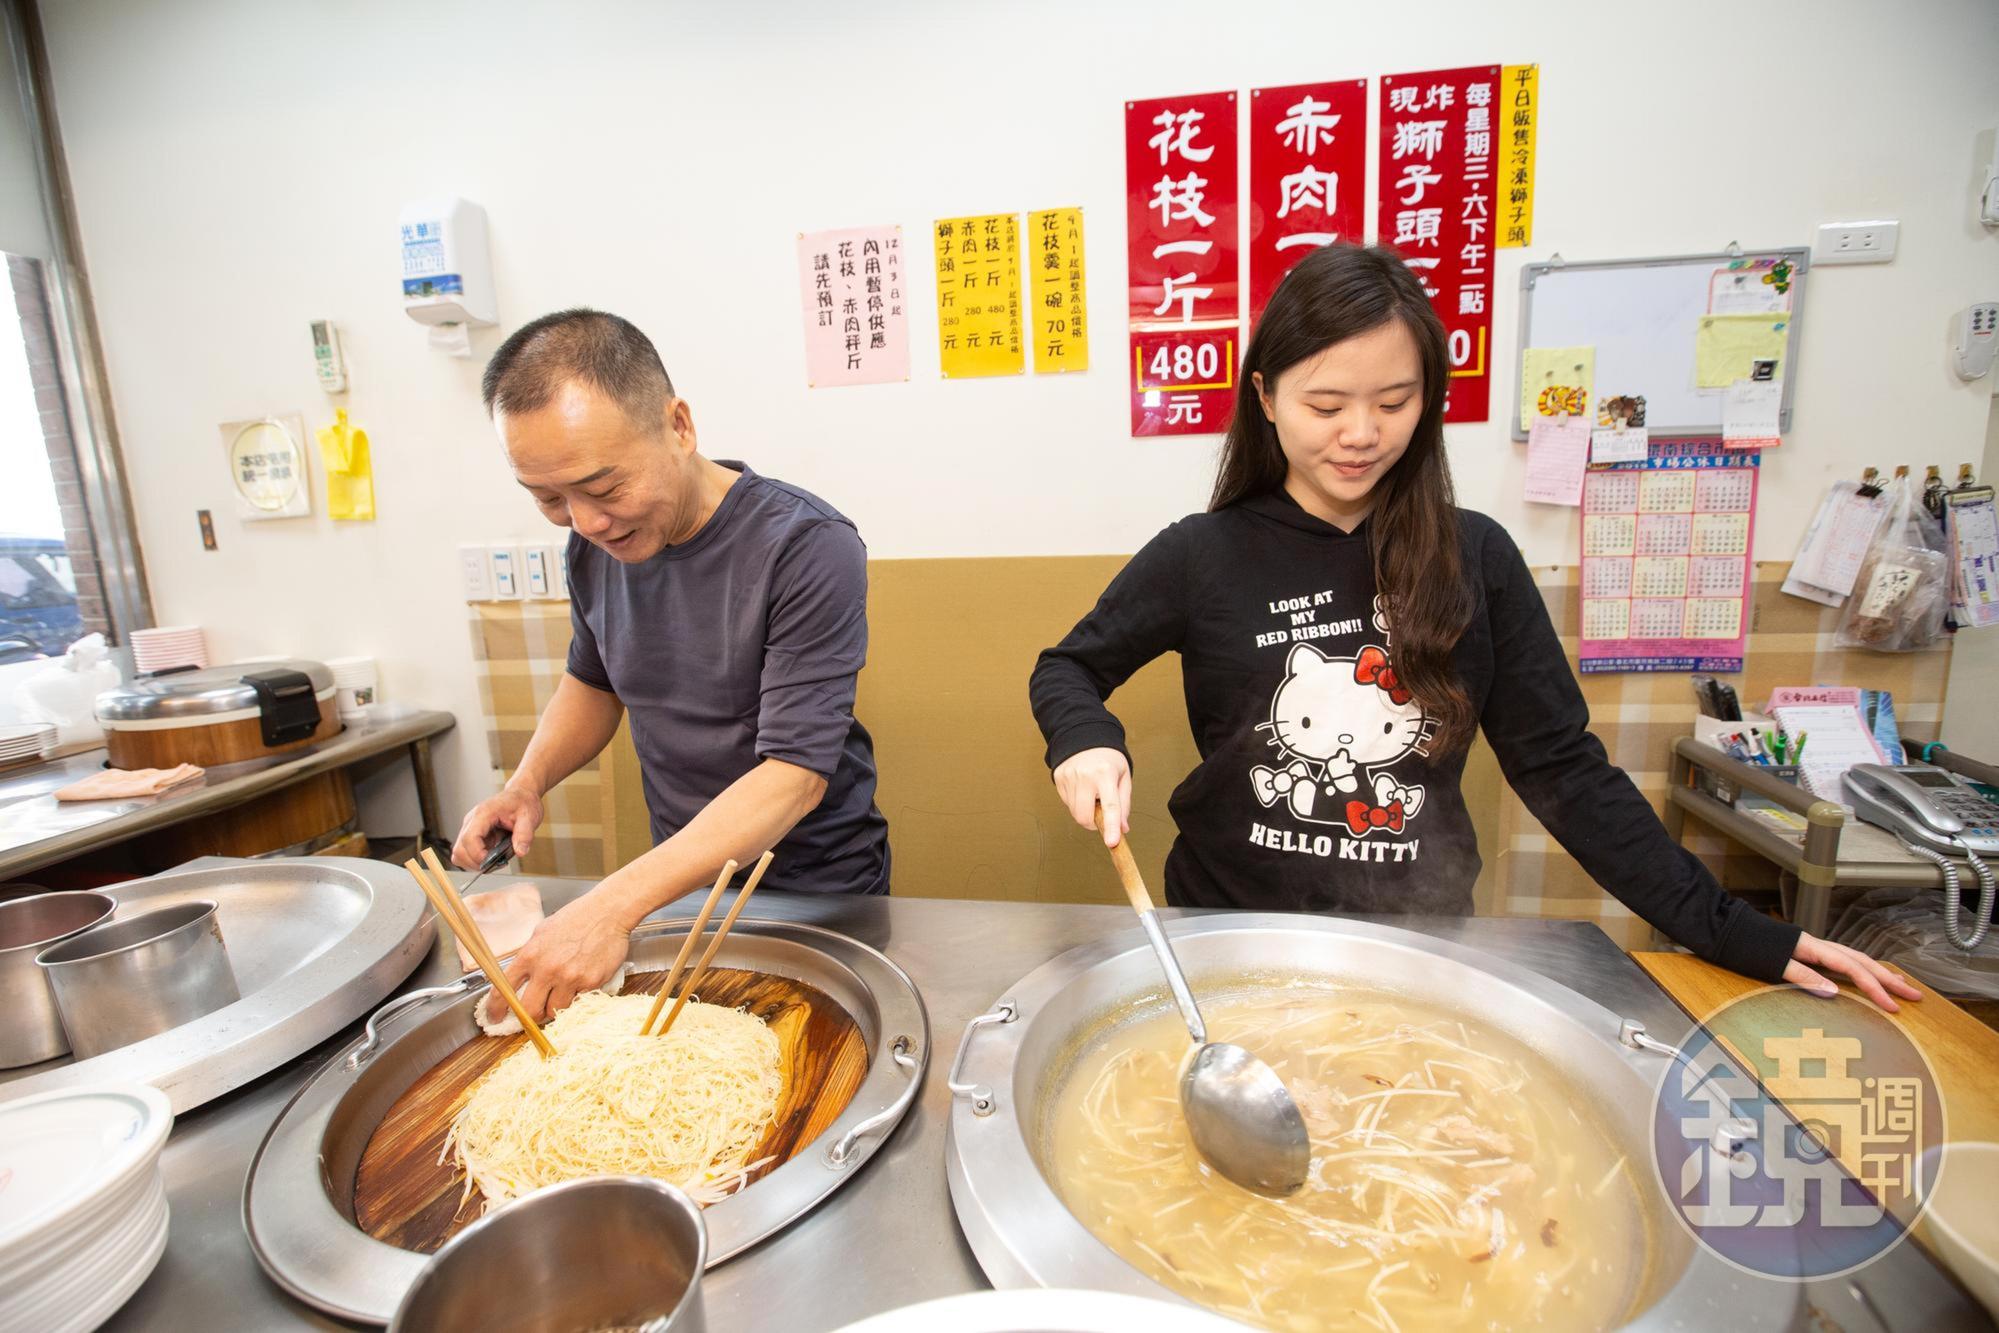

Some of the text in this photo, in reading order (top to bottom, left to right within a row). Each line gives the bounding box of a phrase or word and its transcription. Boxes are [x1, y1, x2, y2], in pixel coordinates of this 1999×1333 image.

[1389, 84, 1455, 114] 現炸
[1275, 95, 1342, 276] 赤肉一
[1148, 108, 1216, 326] 花枝一斤
[1392, 120, 1448, 298] 獅子頭一
[1150, 343, 1218, 381] 480
[1168, 395, 1202, 425] 元
[1269, 590, 1334, 614] LOOK AT
[1290, 610, 1317, 626] MY
[1256, 618, 1363, 648] RED RIBBON!!
[1249, 822, 1420, 864] HELLO KITTY
